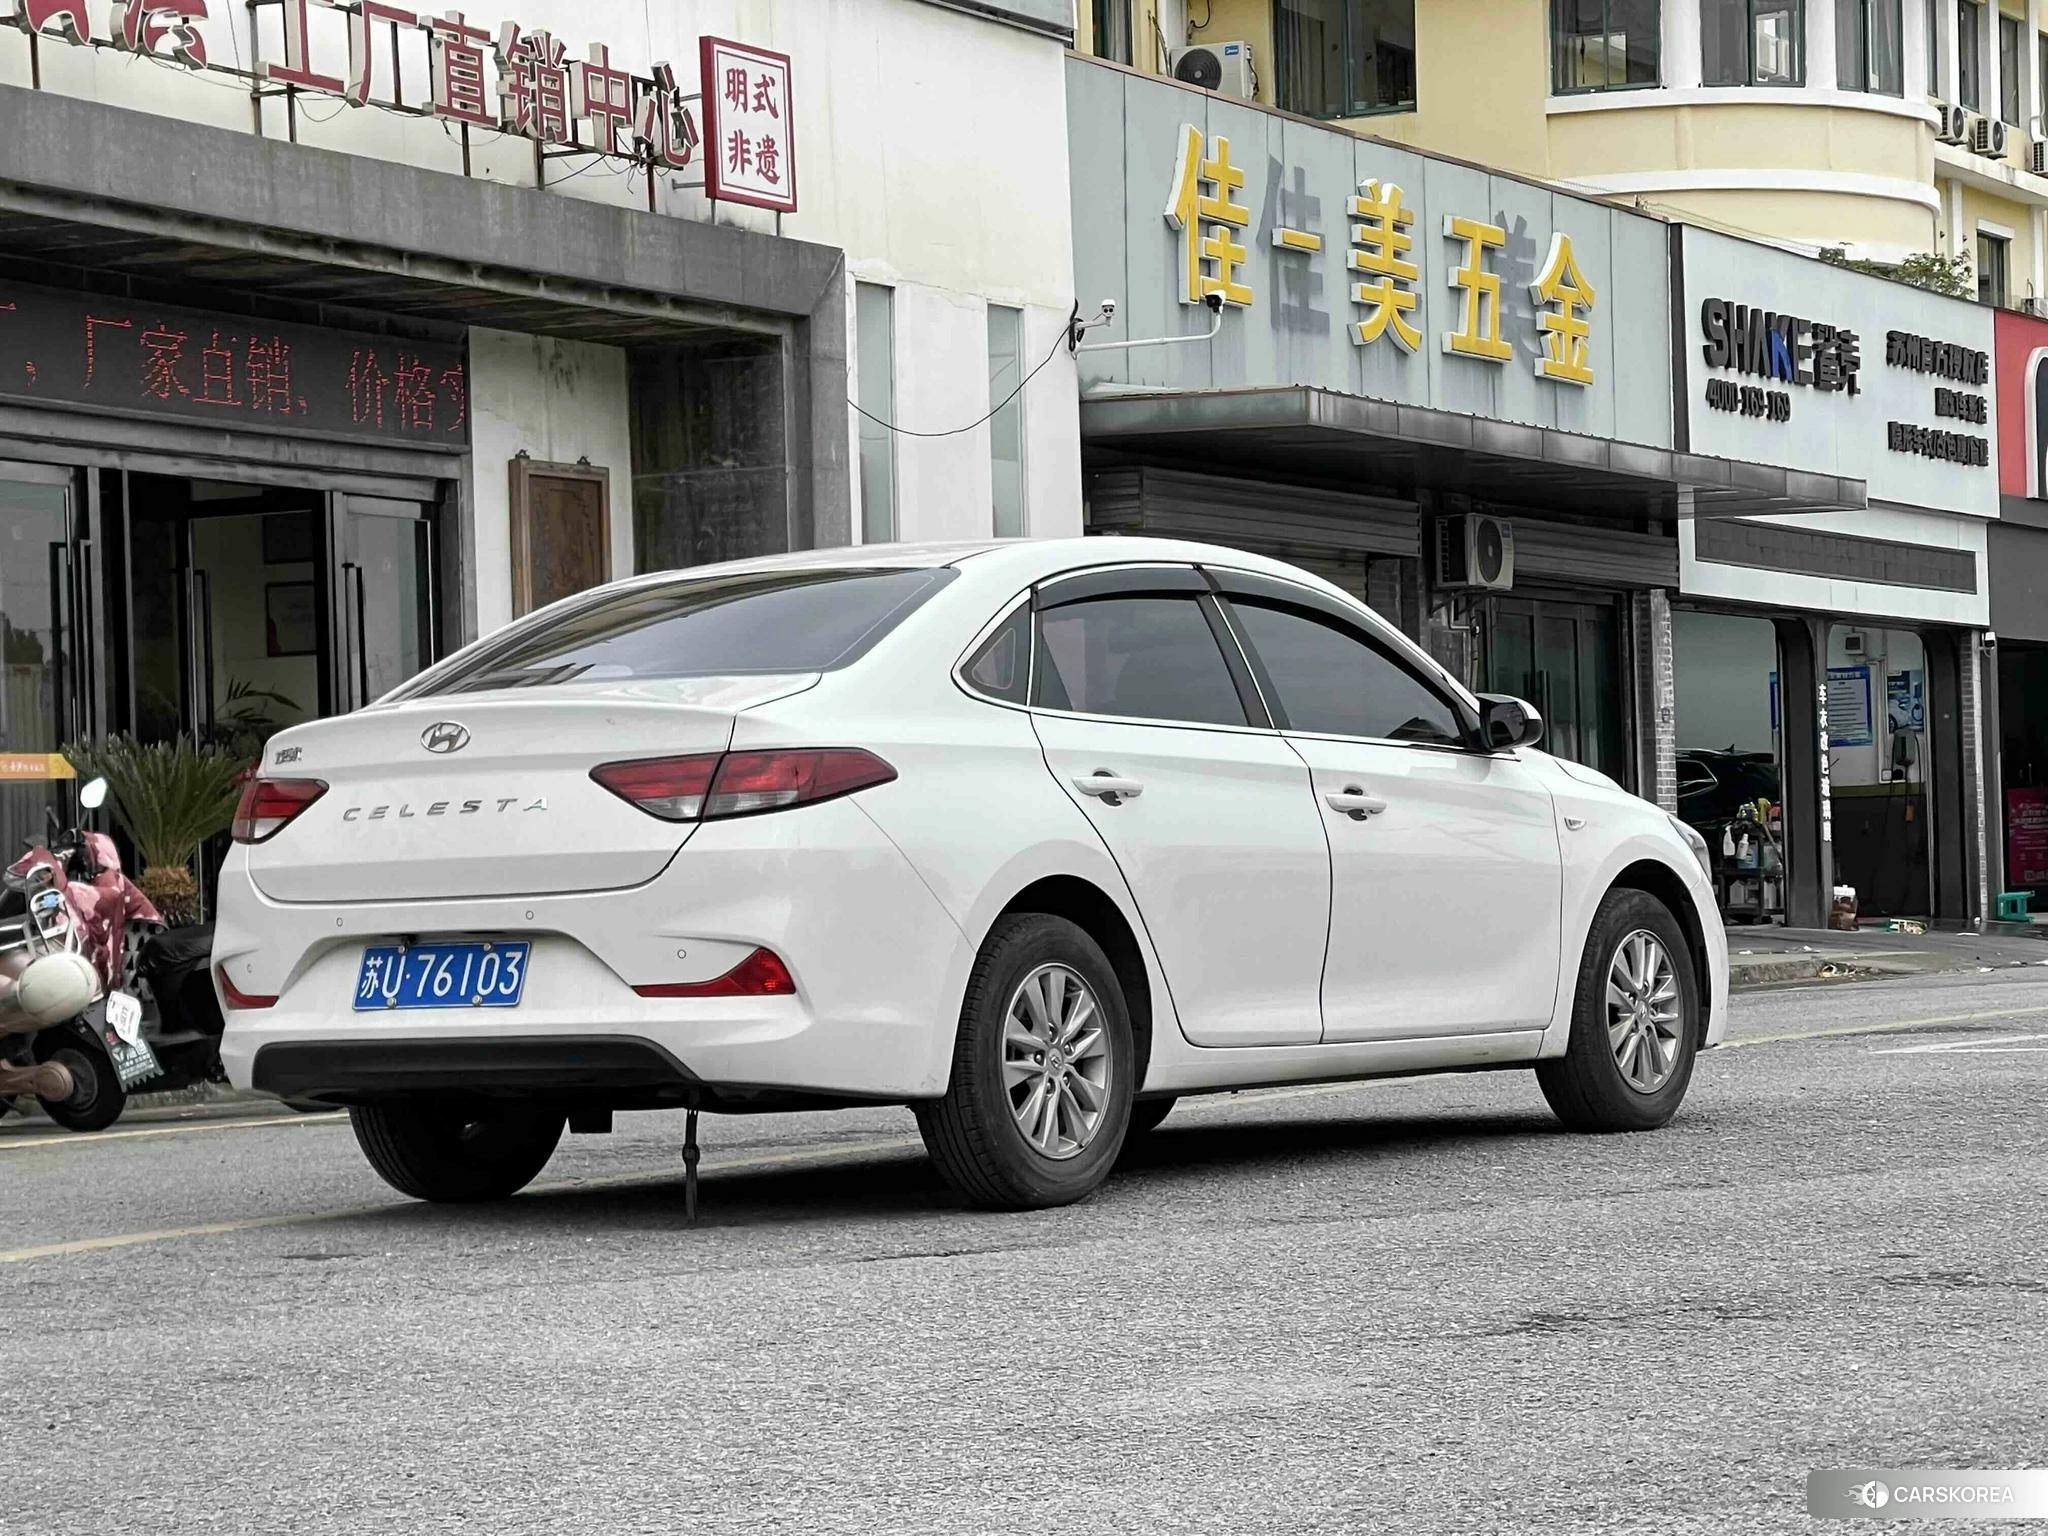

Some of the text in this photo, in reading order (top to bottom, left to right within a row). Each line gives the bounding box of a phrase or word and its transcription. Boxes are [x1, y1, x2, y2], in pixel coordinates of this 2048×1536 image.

[725, 68, 779, 119] 明式
[729, 129, 781, 184] 非遗
[1701, 297, 1813, 386] SHAKE
[343, 798, 548, 822] CELESTA
